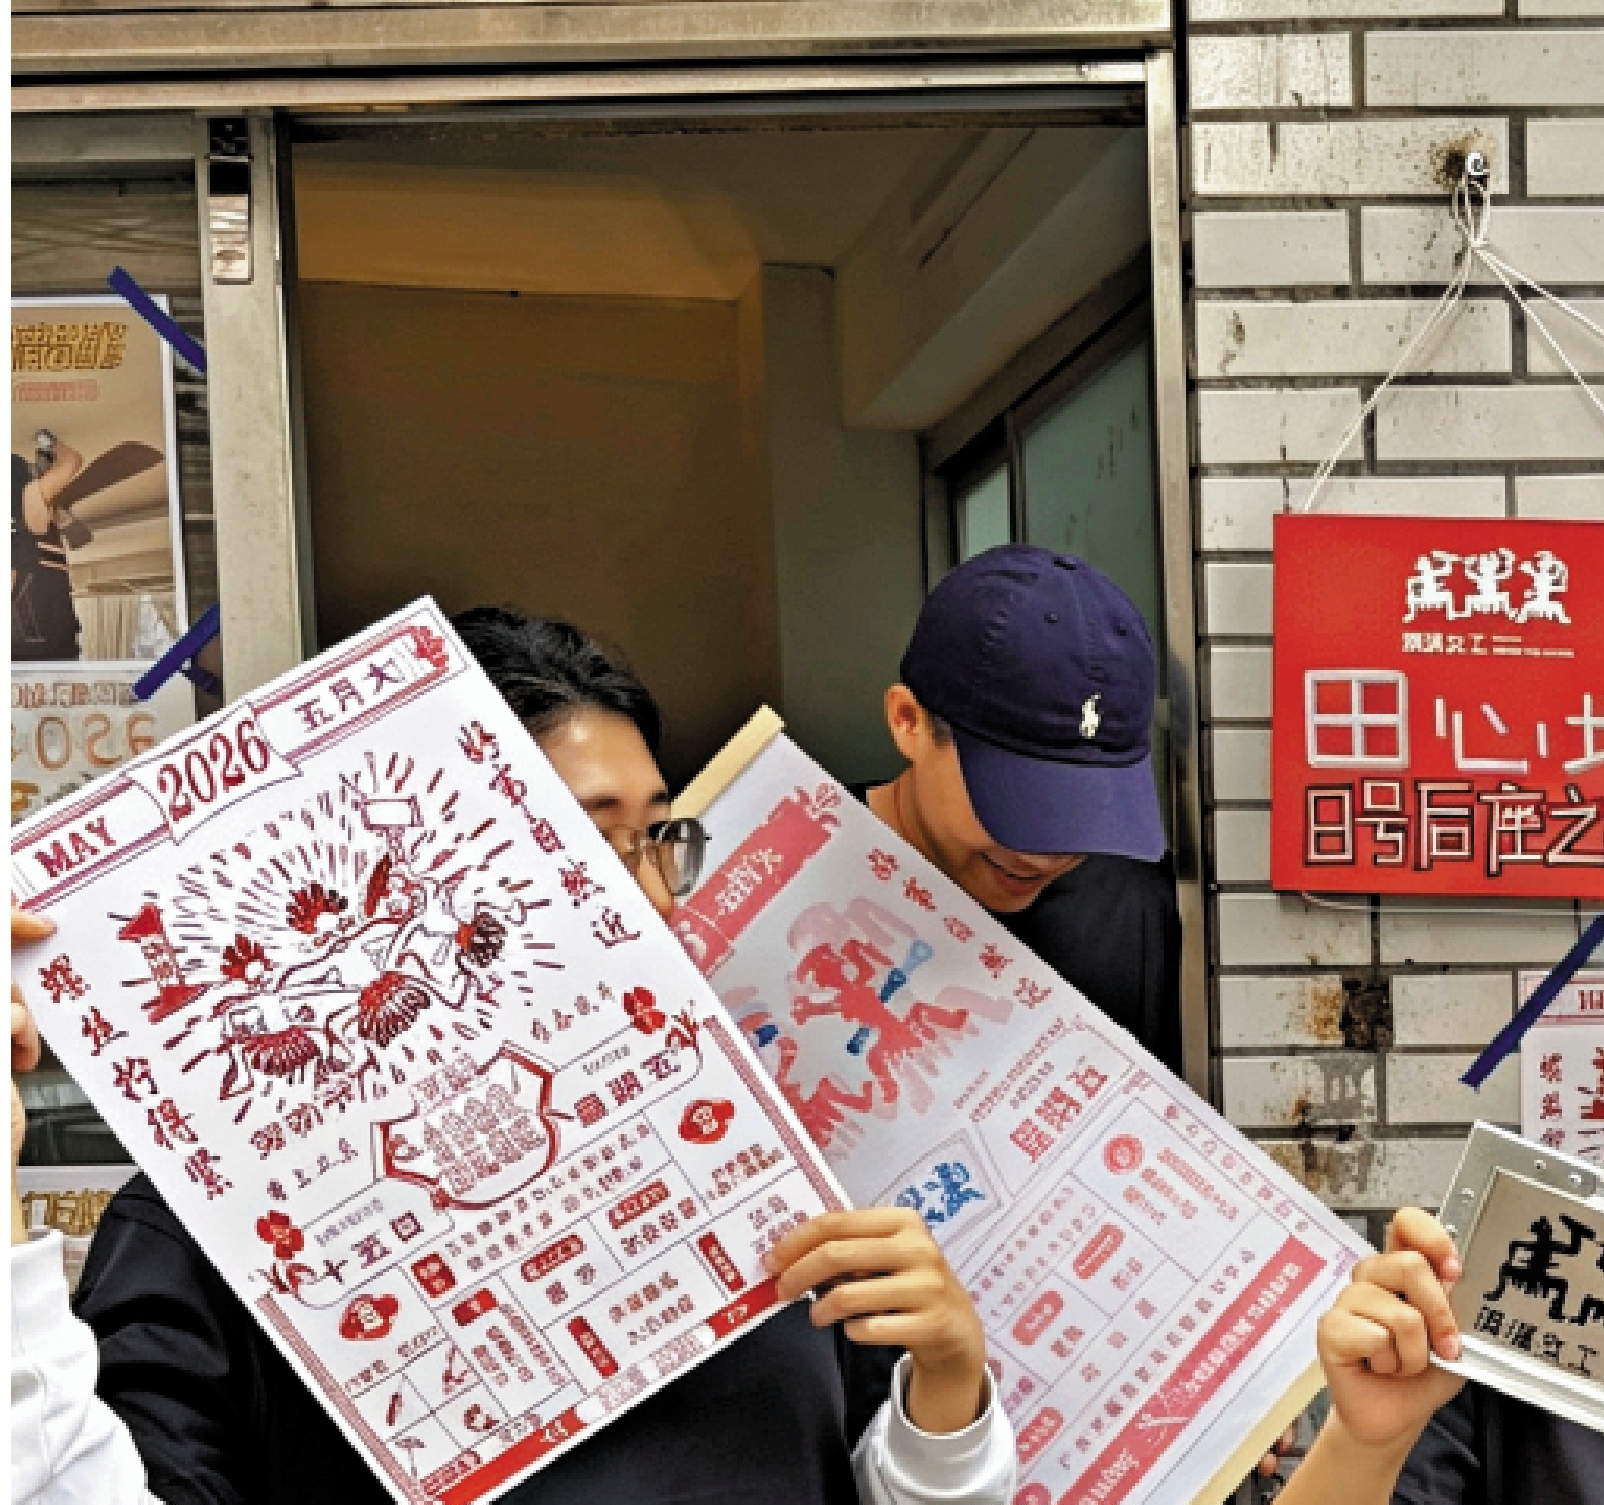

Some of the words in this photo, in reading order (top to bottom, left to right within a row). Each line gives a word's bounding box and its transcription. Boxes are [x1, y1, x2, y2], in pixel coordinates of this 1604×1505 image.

[298, 662, 398, 728] 五月大
[11, 713, 156, 770] 026
[160, 721, 268, 816] 2026
[36, 820, 115, 875] MAY
[40, 957, 231, 1200] 螺丝拧得紧
[324, 1212, 422, 1282] 十五日
